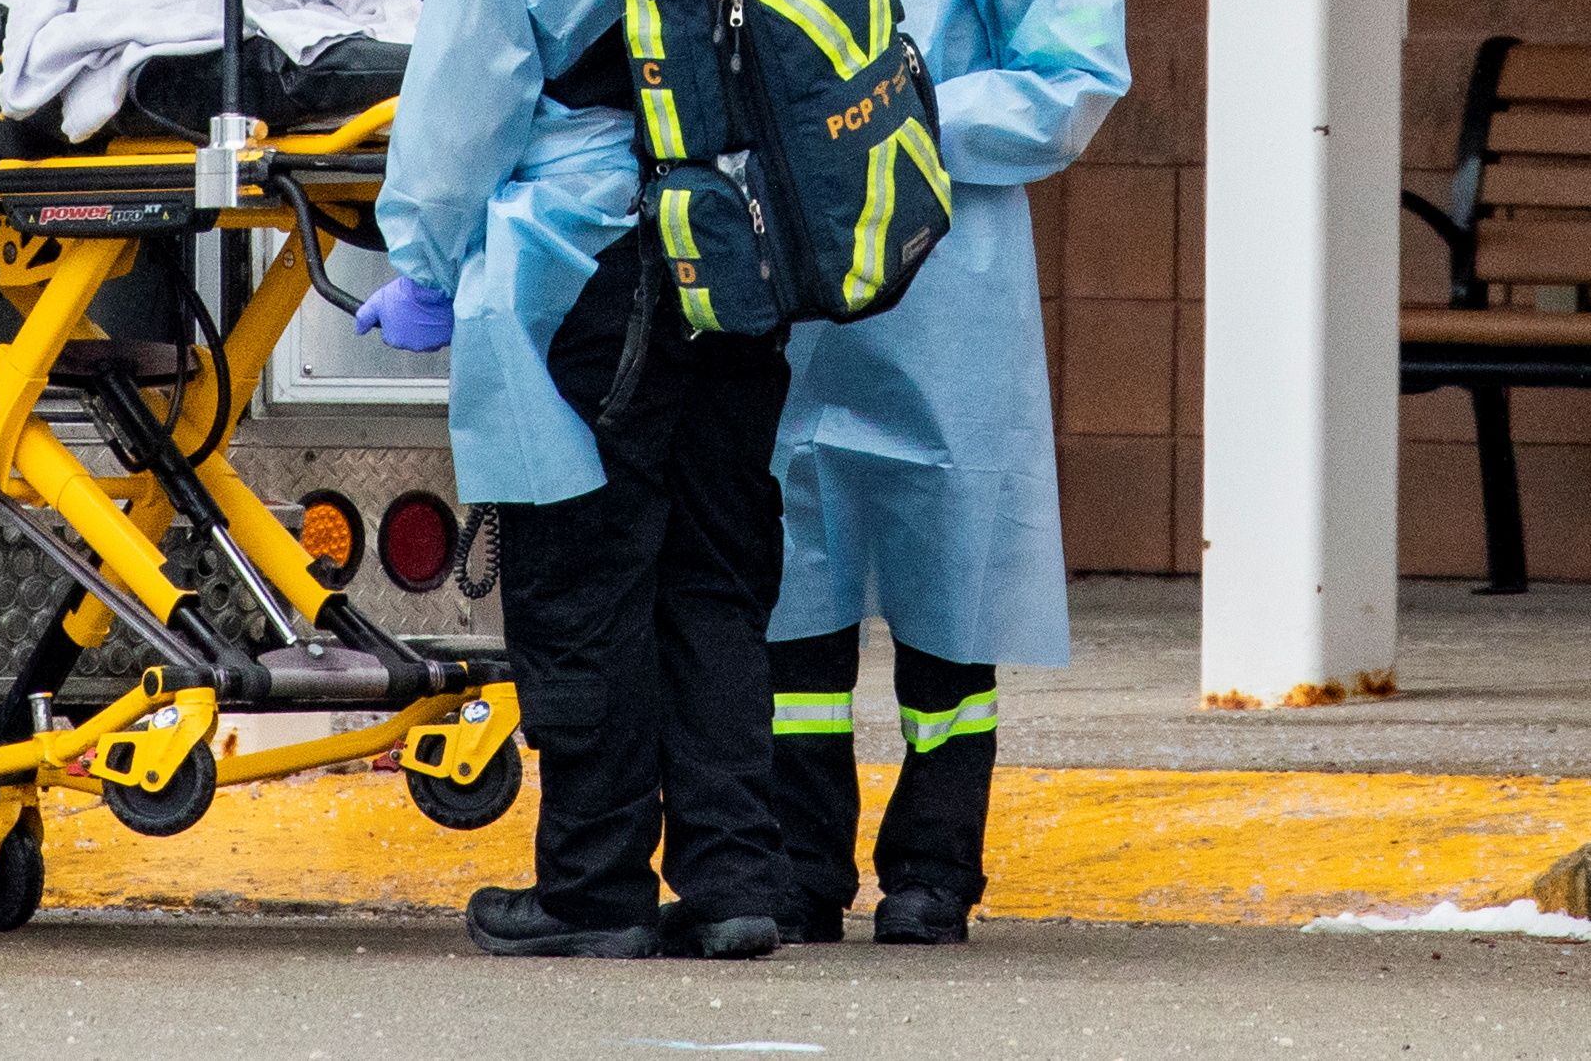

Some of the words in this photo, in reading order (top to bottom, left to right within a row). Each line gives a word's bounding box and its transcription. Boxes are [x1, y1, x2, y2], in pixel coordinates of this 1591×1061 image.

[642, 62, 662, 85] C
[826, 98, 873, 140] PCP
[676, 260, 697, 284] D
